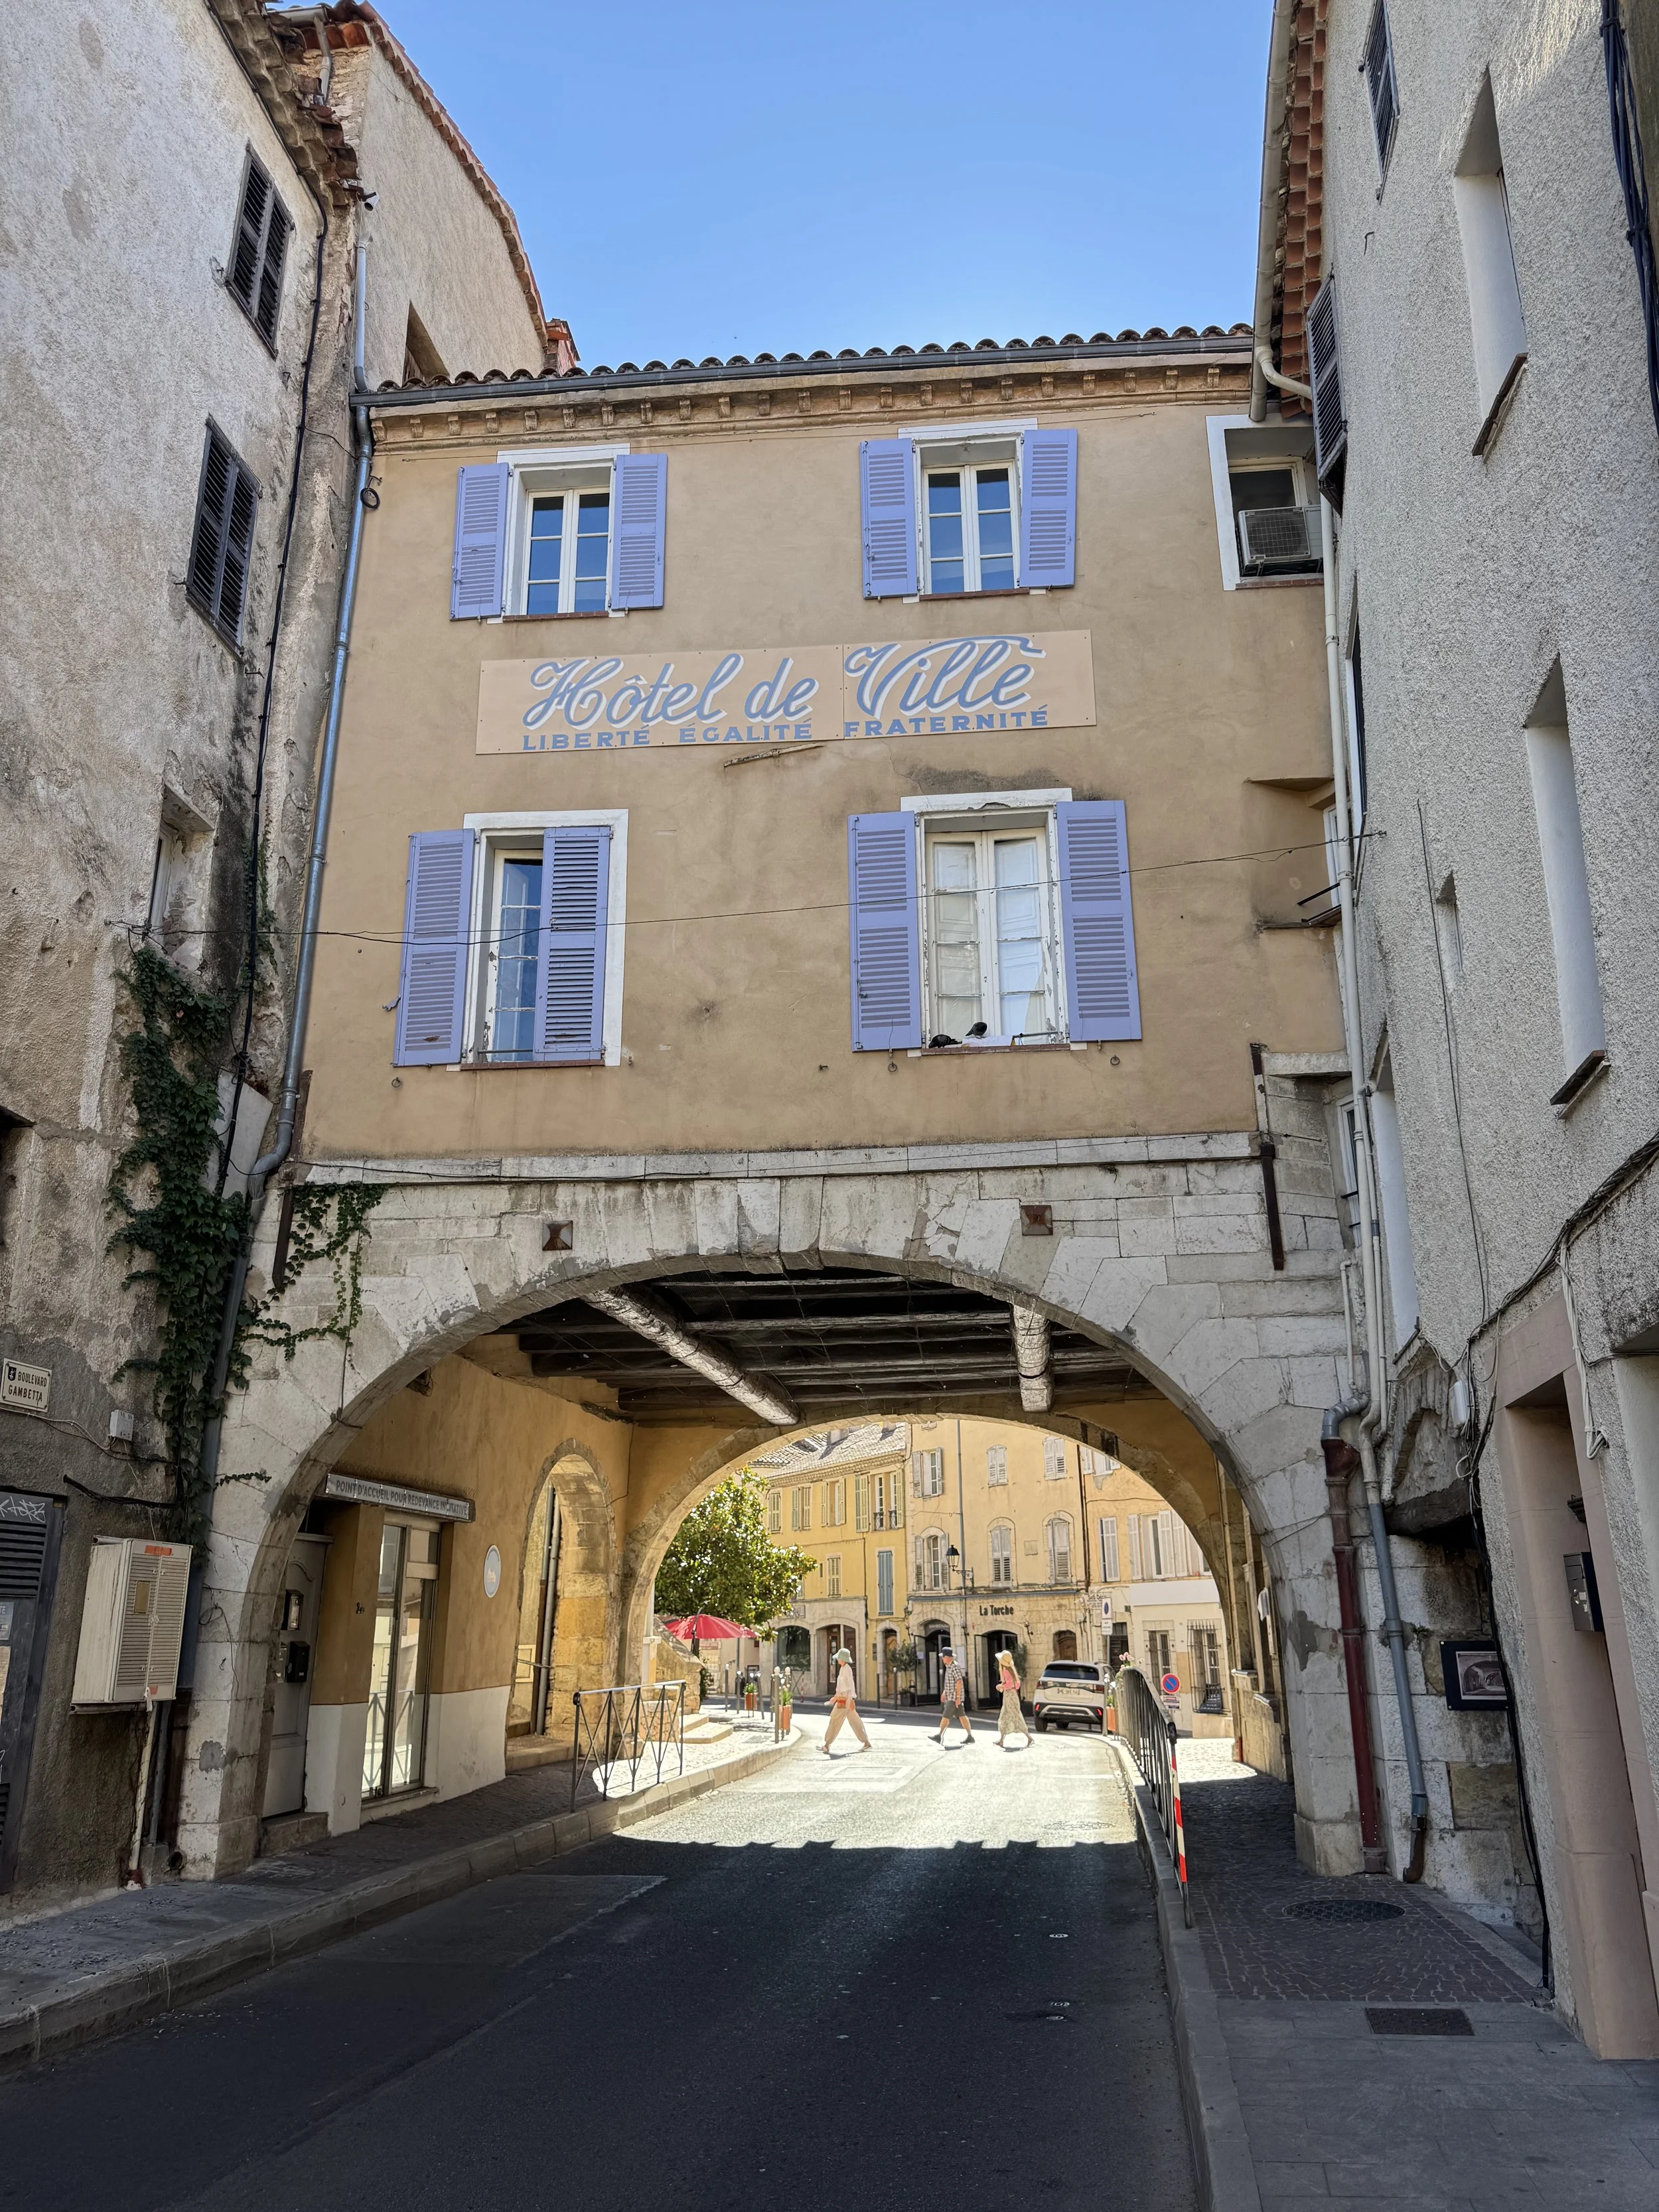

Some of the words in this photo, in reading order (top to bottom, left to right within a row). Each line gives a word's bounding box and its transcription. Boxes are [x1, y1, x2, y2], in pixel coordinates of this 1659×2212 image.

[522, 652, 744, 731] Hôtel
[744, 657, 820, 723] de
[844, 634, 1046, 719] Ville
[522, 724, 650, 751] LIBERTÉ
[679, 717, 812, 743] ÉGALITÉ
[843, 704, 1048, 737] FRATERNITÉ
[18, 1371, 47, 1387] BOULEVARD
[8, 1384, 42, 1402] GAMBETTA
[336, 1480, 357, 1494] POINT
[358, 1484, 390, 1501] D'ACCUEIL
[390, 1491, 407, 1504] POUR
[407, 1494, 439, 1511] REDEVANCE
[979, 1605, 988, 1616] La
[989, 1604, 1014, 1616] Torche
